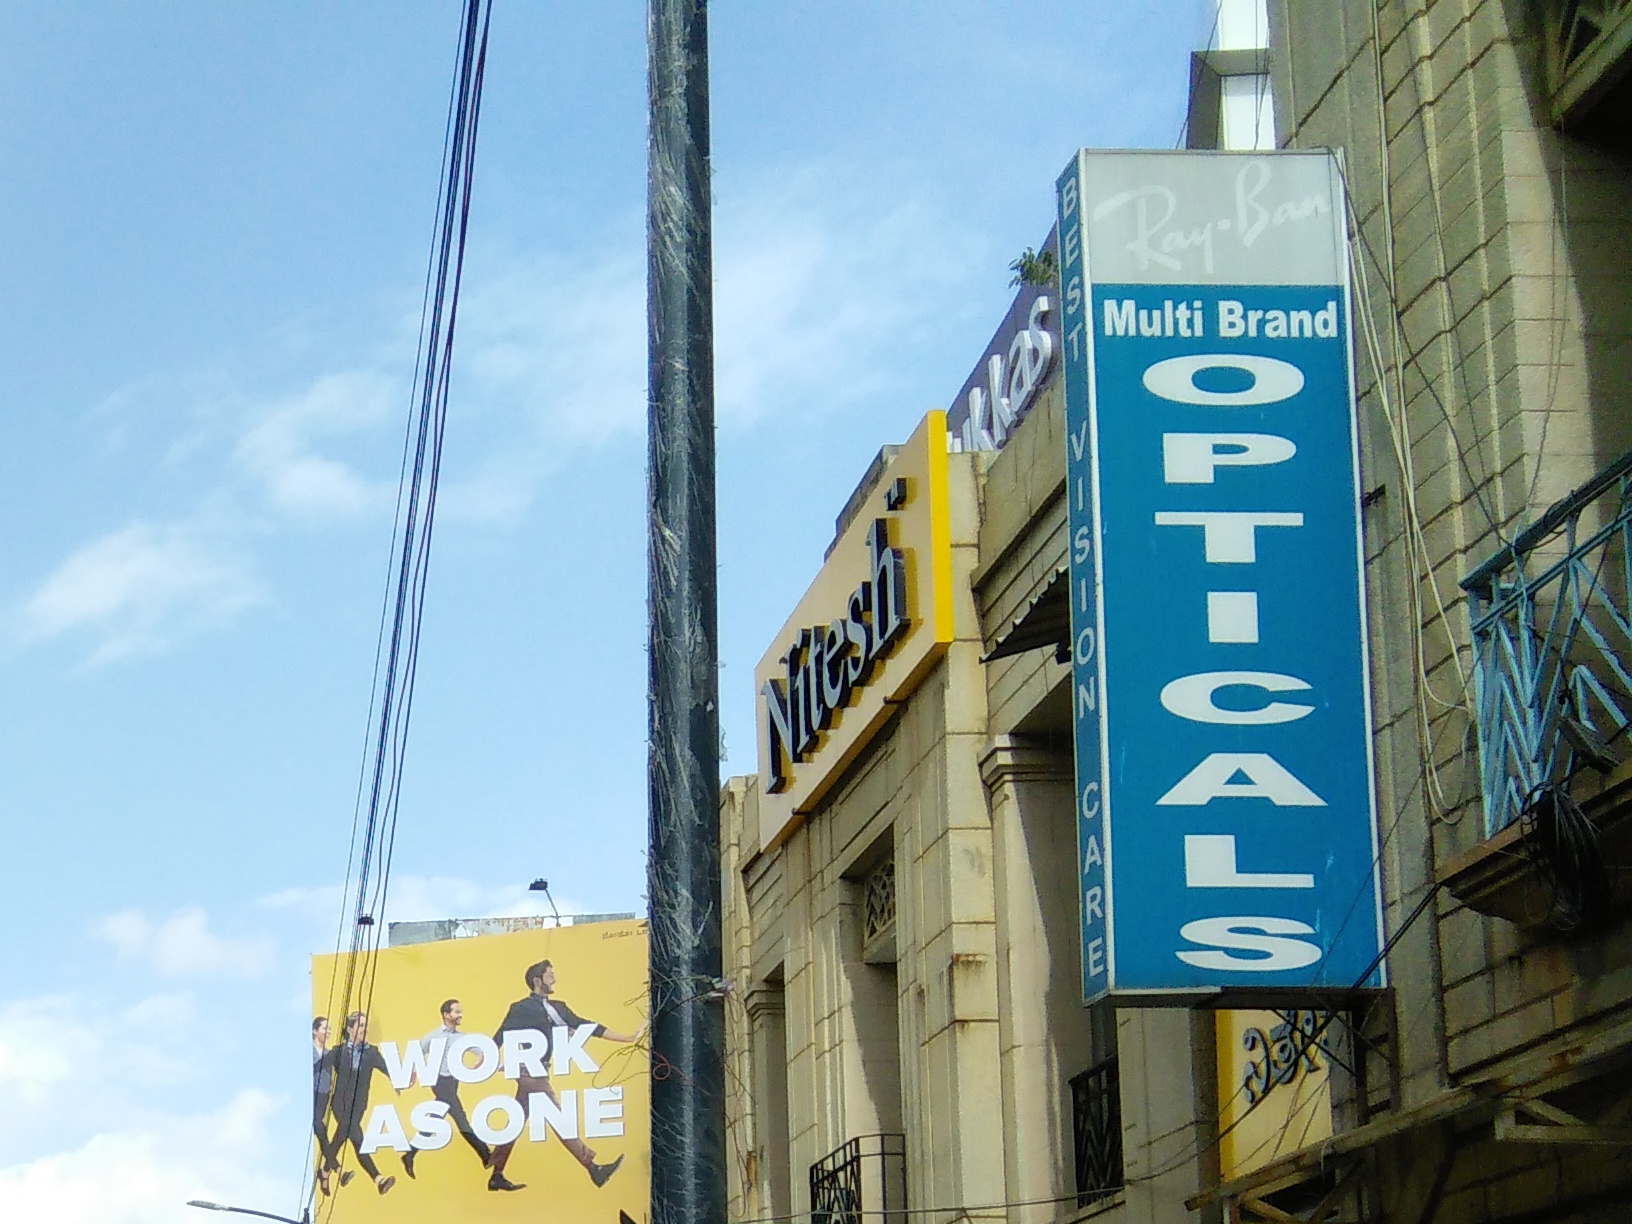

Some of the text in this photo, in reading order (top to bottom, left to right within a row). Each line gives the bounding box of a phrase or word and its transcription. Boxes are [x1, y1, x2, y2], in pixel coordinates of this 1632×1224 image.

[947, 294, 1054, 454] kkas
[1102, 298, 1339, 339] Multi Brand
[761, 516, 916, 796] Nitesh
[1061, 175, 1104, 978] BEST VISION CARE
[1142, 354, 1329, 972] OPTICALS
[359, 1086, 625, 1155] AS ONE
[380, 1023, 600, 1090] WORK
